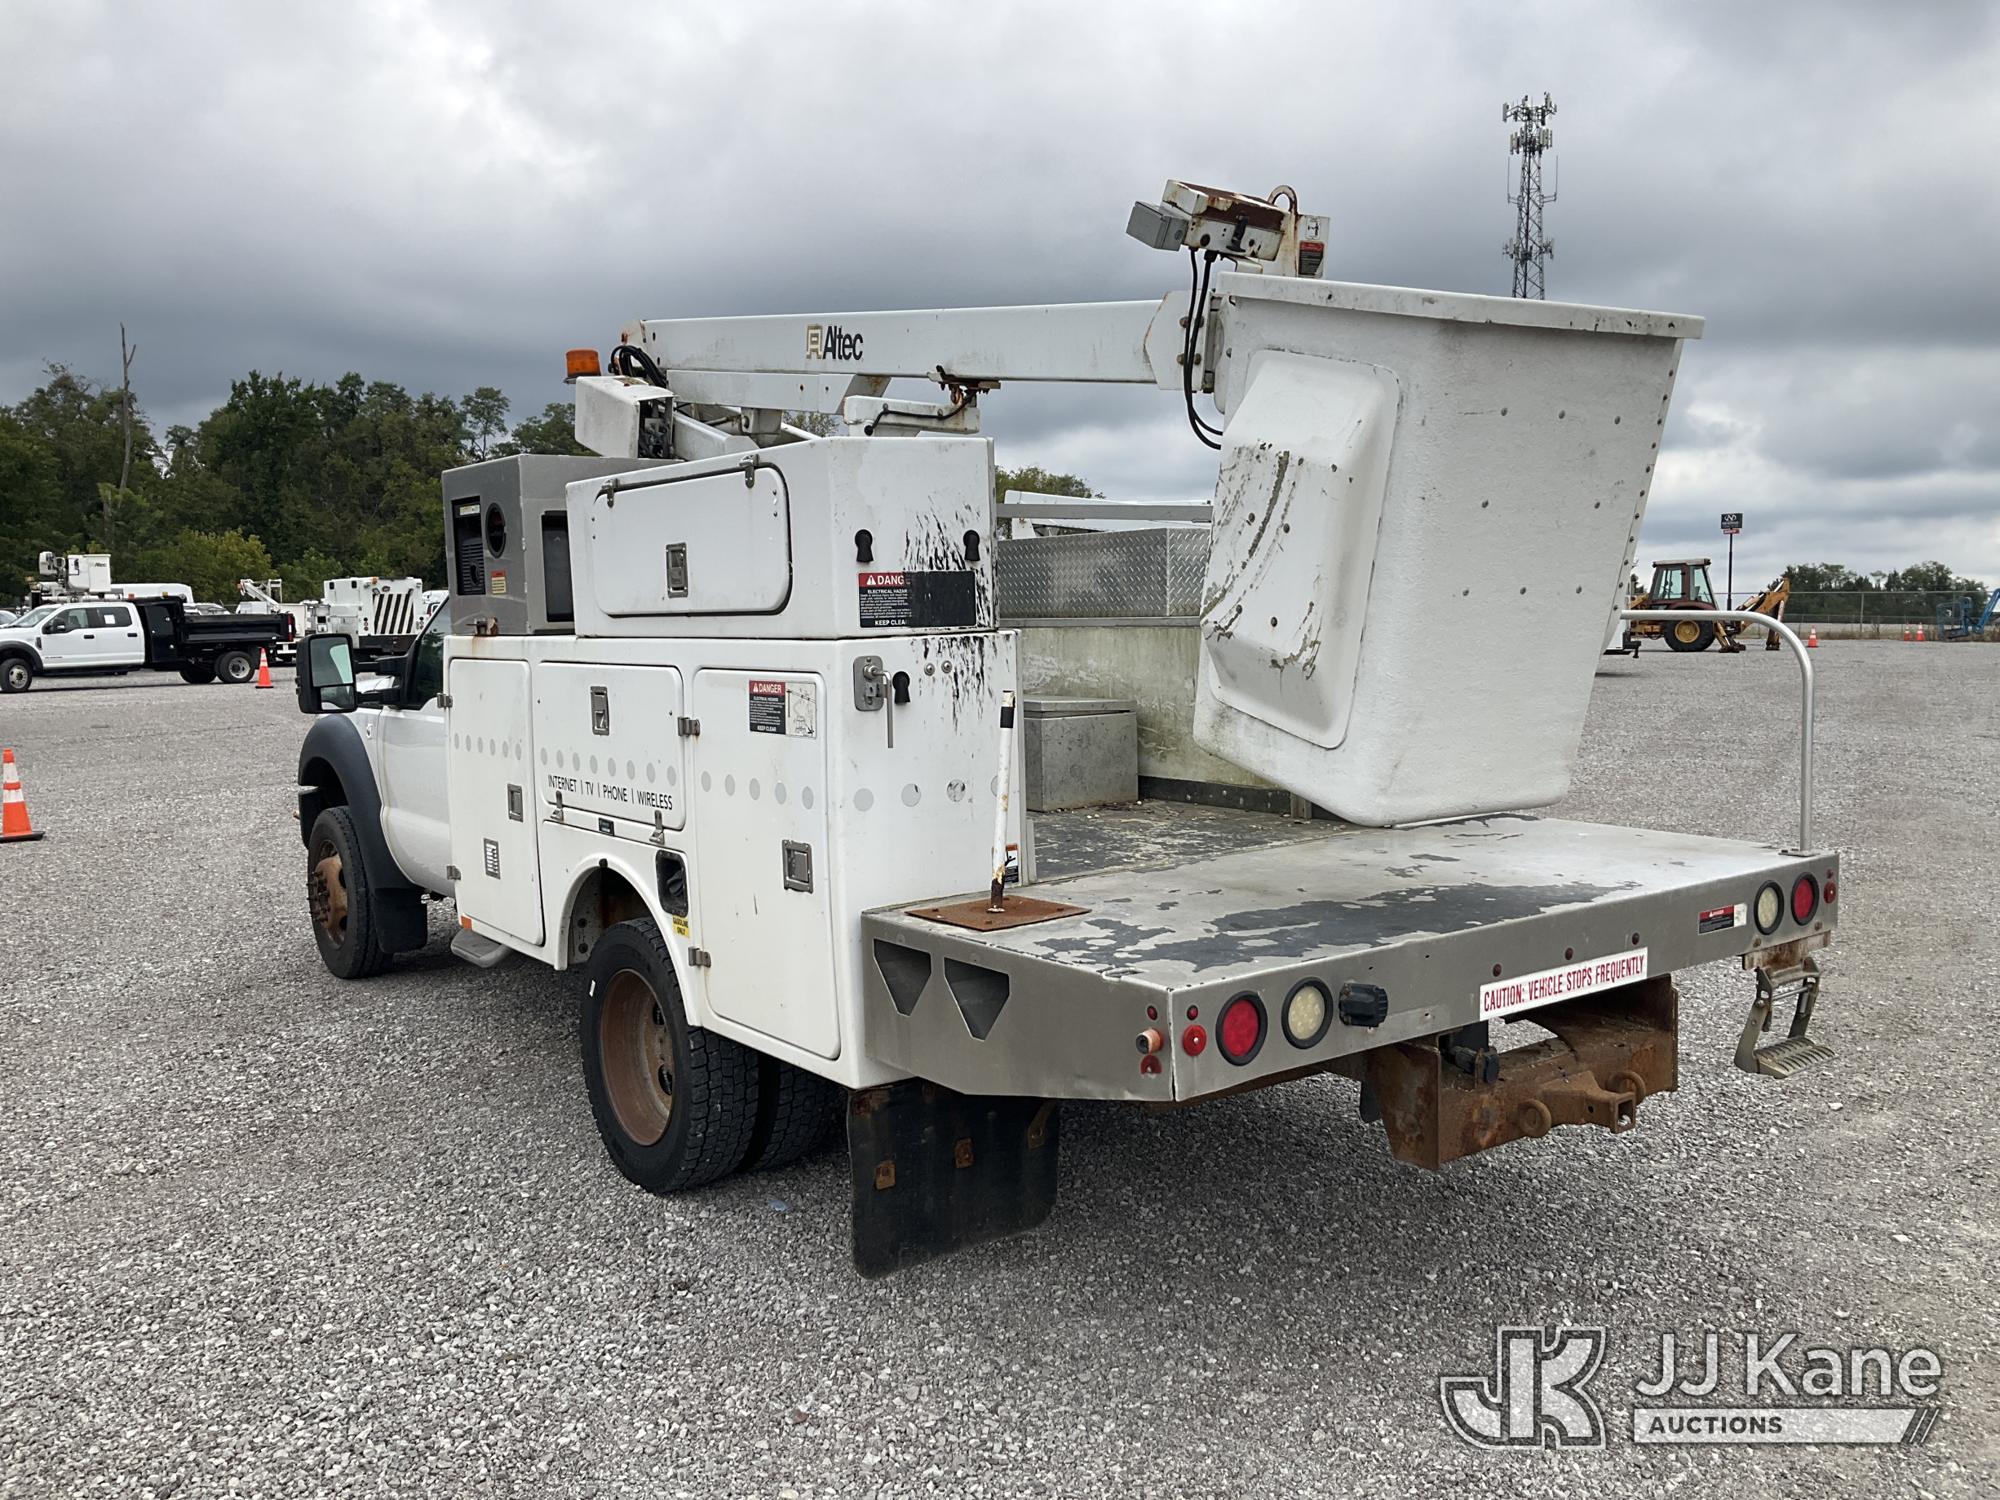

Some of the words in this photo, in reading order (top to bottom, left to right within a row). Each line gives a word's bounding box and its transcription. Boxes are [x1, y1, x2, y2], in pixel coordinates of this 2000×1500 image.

[822, 325, 864, 361] Altec
[758, 683, 782, 694] DANGER
[547, 774, 577, 792] INTERNET
[585, 781, 594, 796] TV
[603, 784, 628, 802] PHONE
[636, 789, 673, 811] WIRELESS
[1483, 985, 1525, 1012] CAUTION:
[1528, 974, 1563, 1001] VEHICLE
[1566, 966, 1593, 991] STOPS
[1595, 955, 1646, 985] FREQUENTLY
